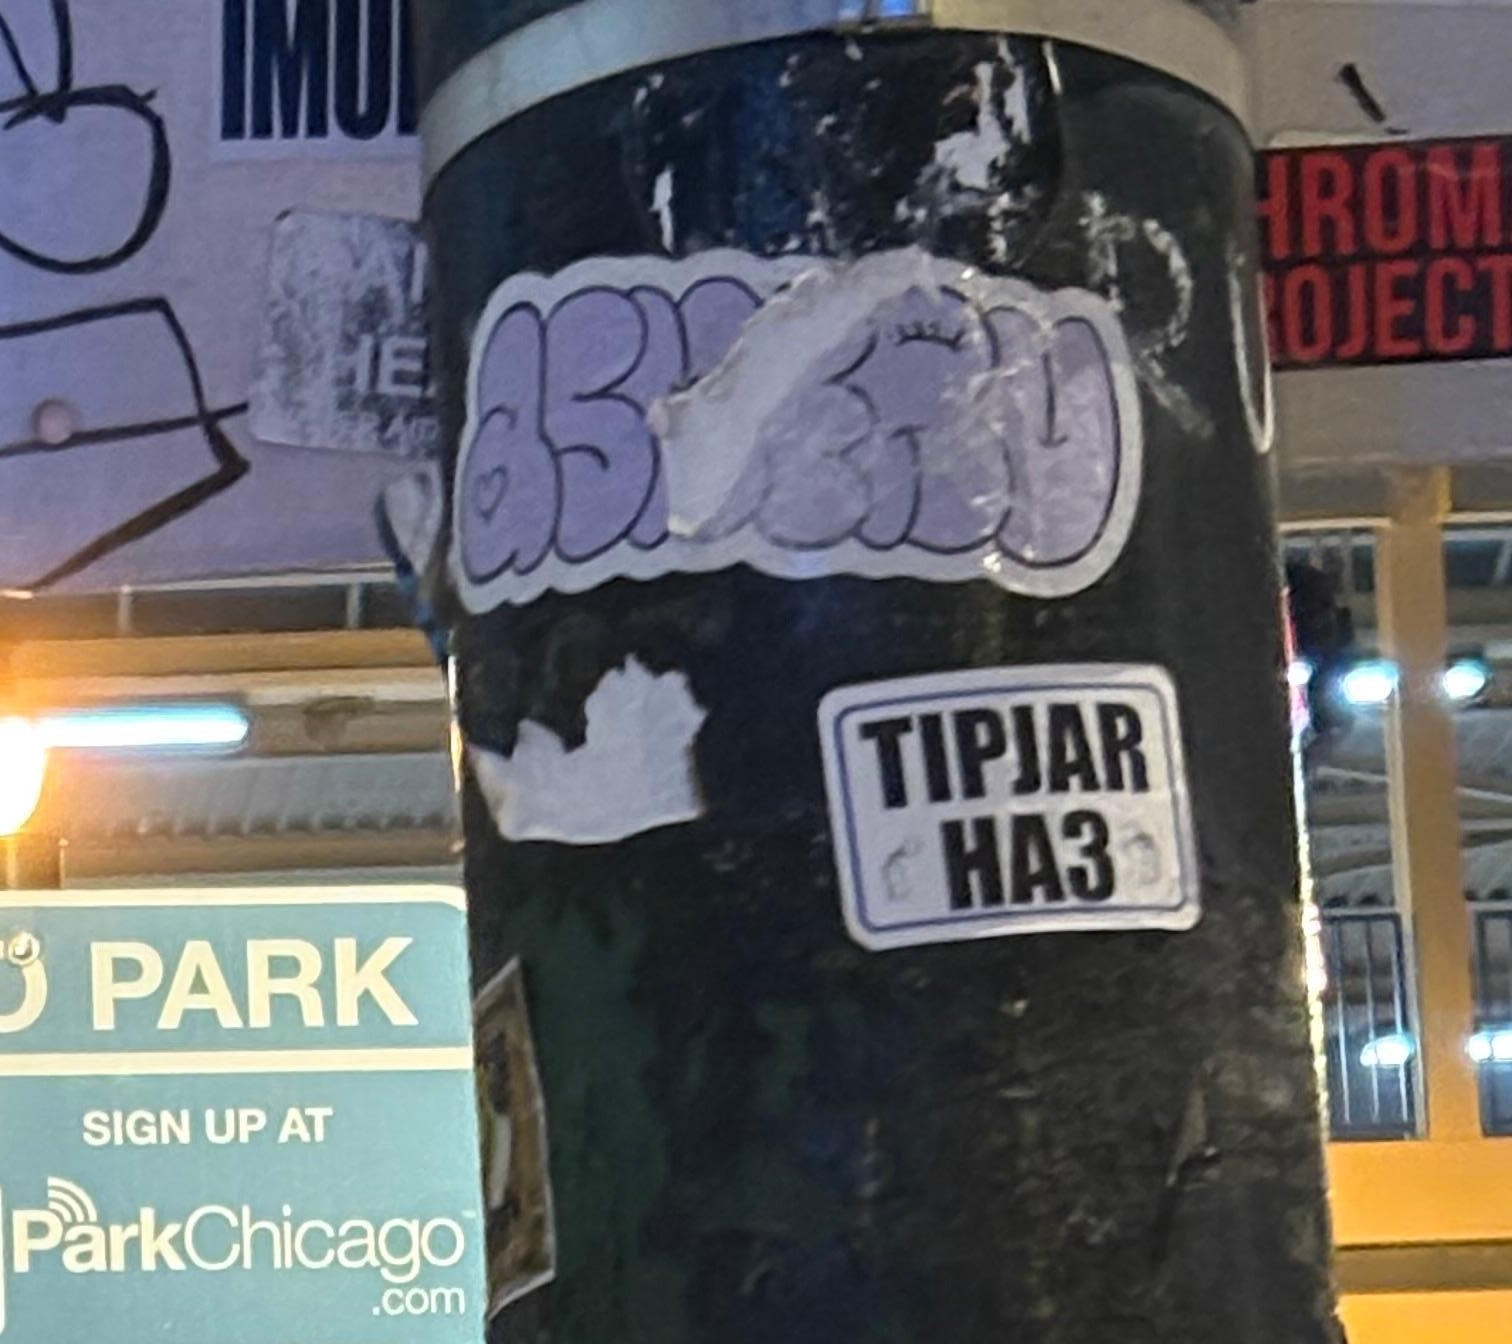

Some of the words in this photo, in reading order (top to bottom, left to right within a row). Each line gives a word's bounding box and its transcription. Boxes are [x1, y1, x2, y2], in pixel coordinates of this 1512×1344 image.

[859, 701, 1150, 810] TIPJAR
[940, 810, 1116, 911] HA3
[90, 936, 419, 1032] PARK
[82, 1108, 190, 1146] SIGN
[204, 1107, 266, 1143] UP
[278, 1106, 333, 1143] AT
[372, 1286, 465, 1316] .com
